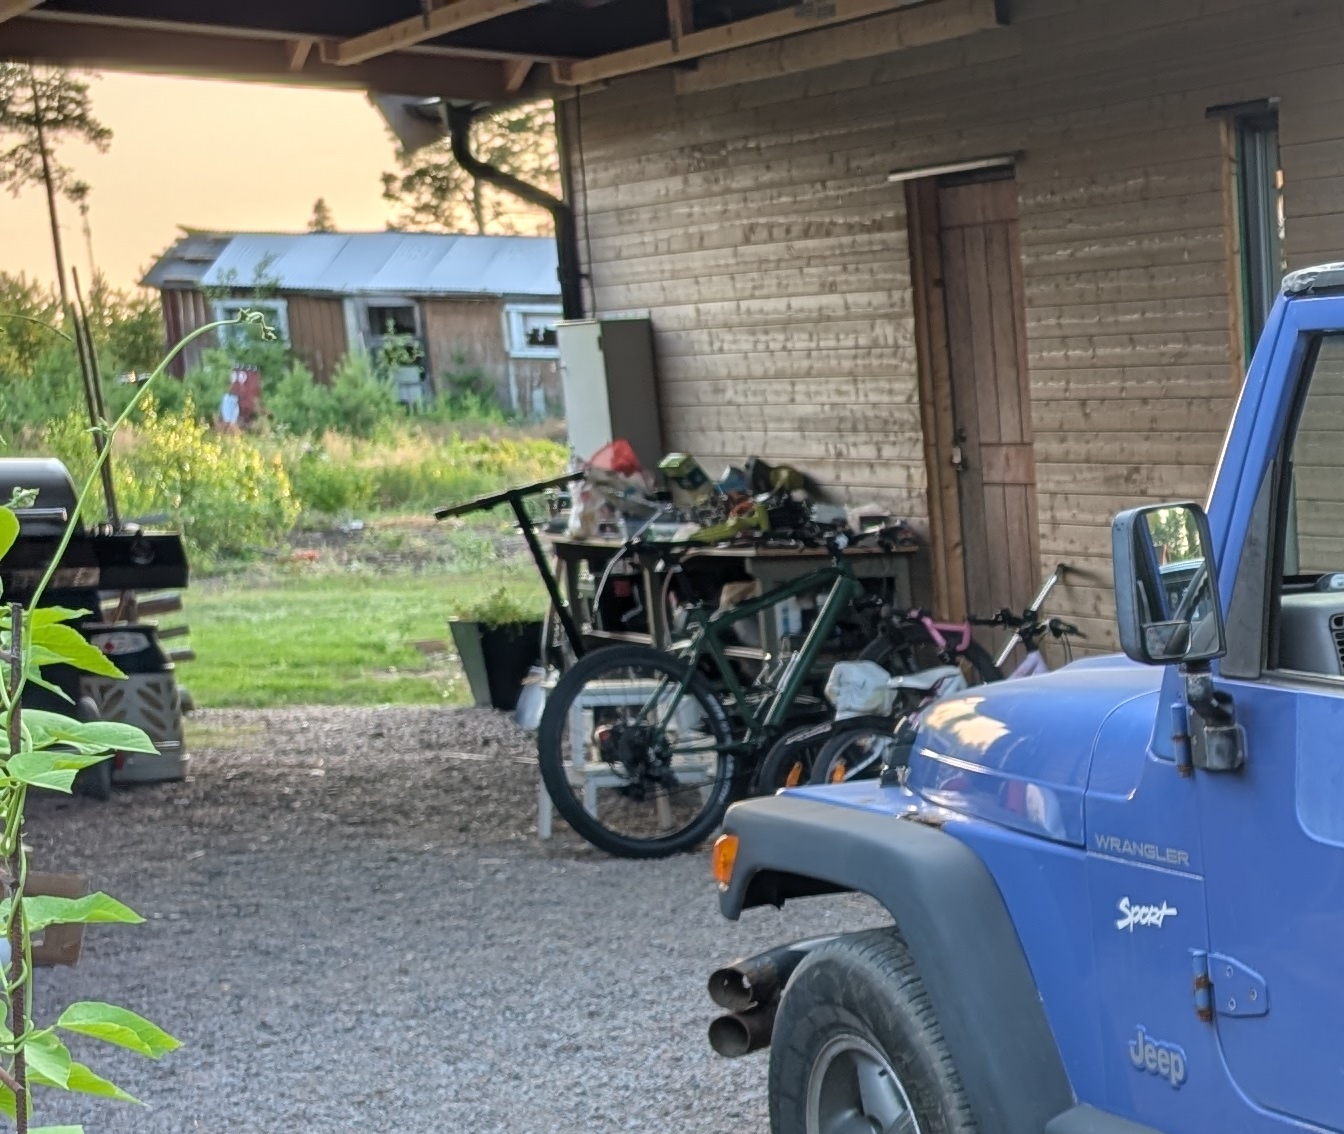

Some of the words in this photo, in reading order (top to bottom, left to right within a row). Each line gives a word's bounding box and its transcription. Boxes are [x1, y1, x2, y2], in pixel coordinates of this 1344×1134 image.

[1094, 833, 1190, 866] WRANGLER
[1116, 896, 1177, 933] Sport
[1128, 1026, 1187, 1090] Jeep
